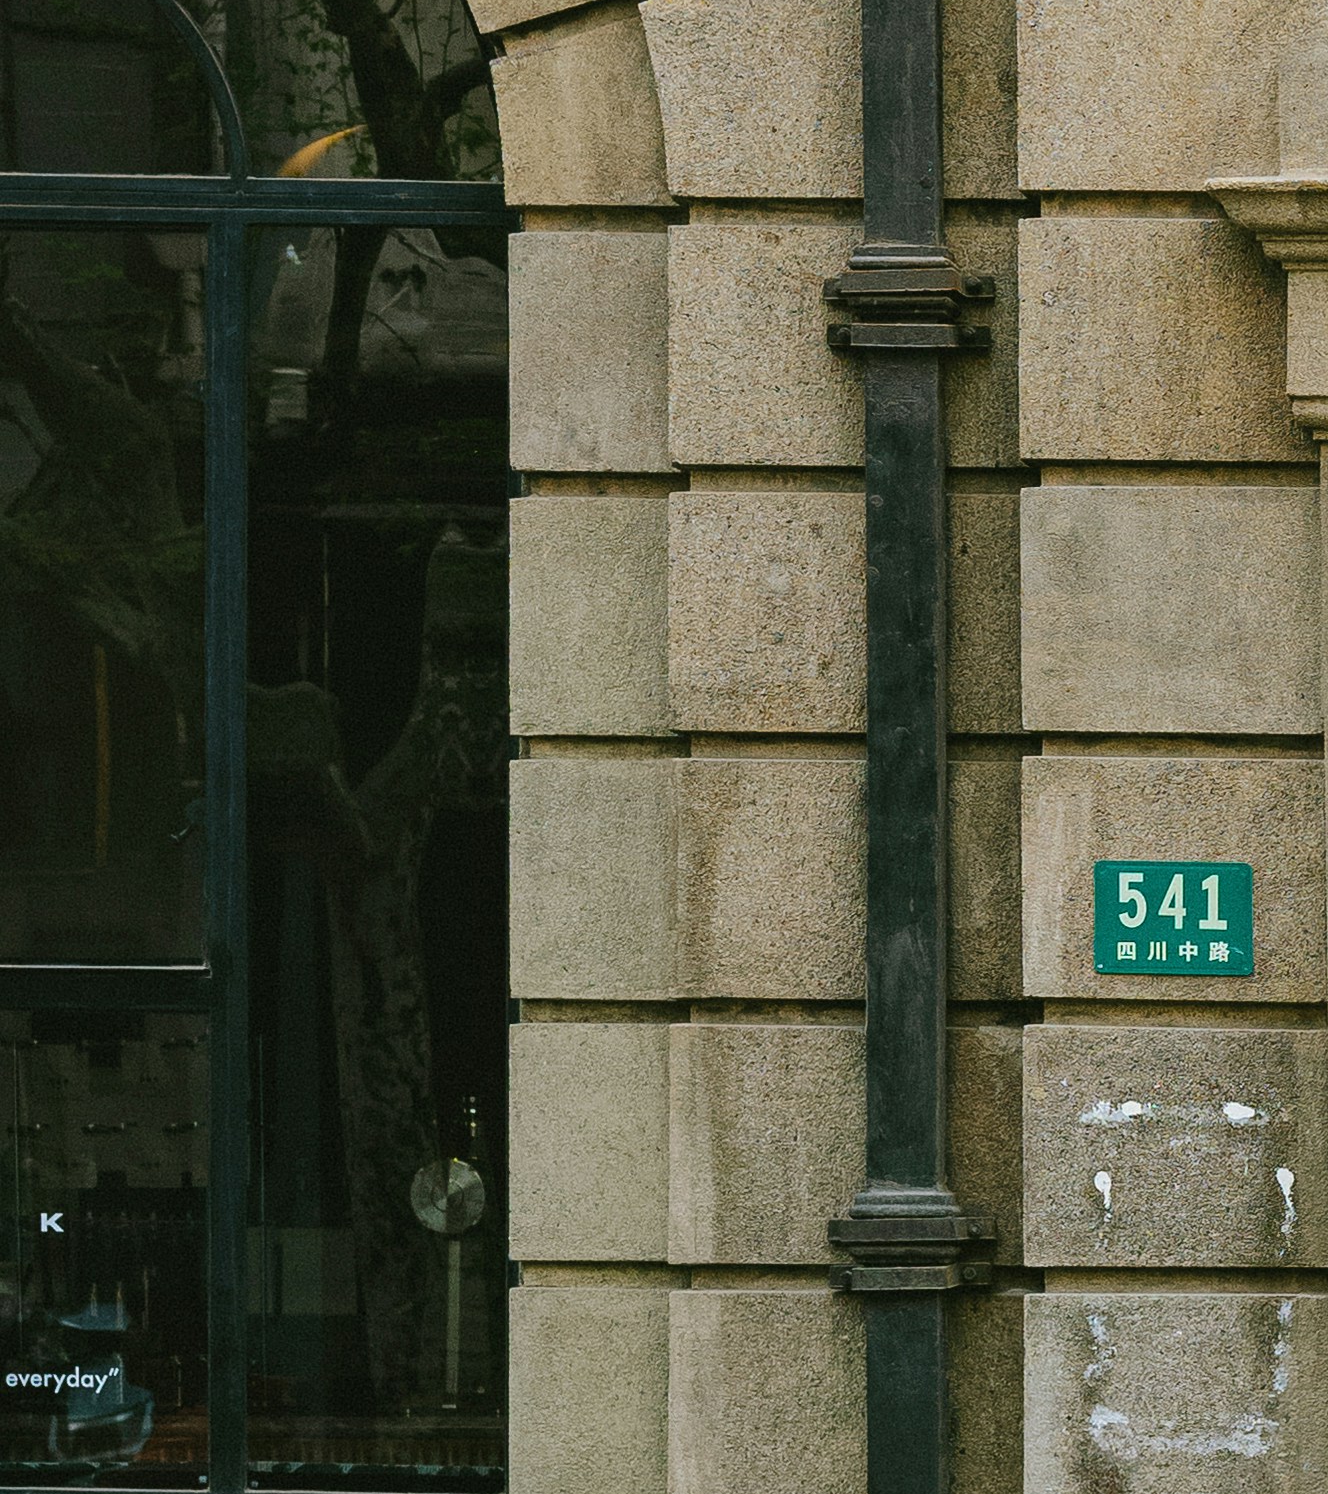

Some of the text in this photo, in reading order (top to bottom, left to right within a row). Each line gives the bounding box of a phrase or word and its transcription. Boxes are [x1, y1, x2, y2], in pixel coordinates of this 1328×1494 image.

[1118, 872, 1228, 931] 541
[1117, 941, 1231, 963] 四川中路
[40, 1213, 64, 1232] K
